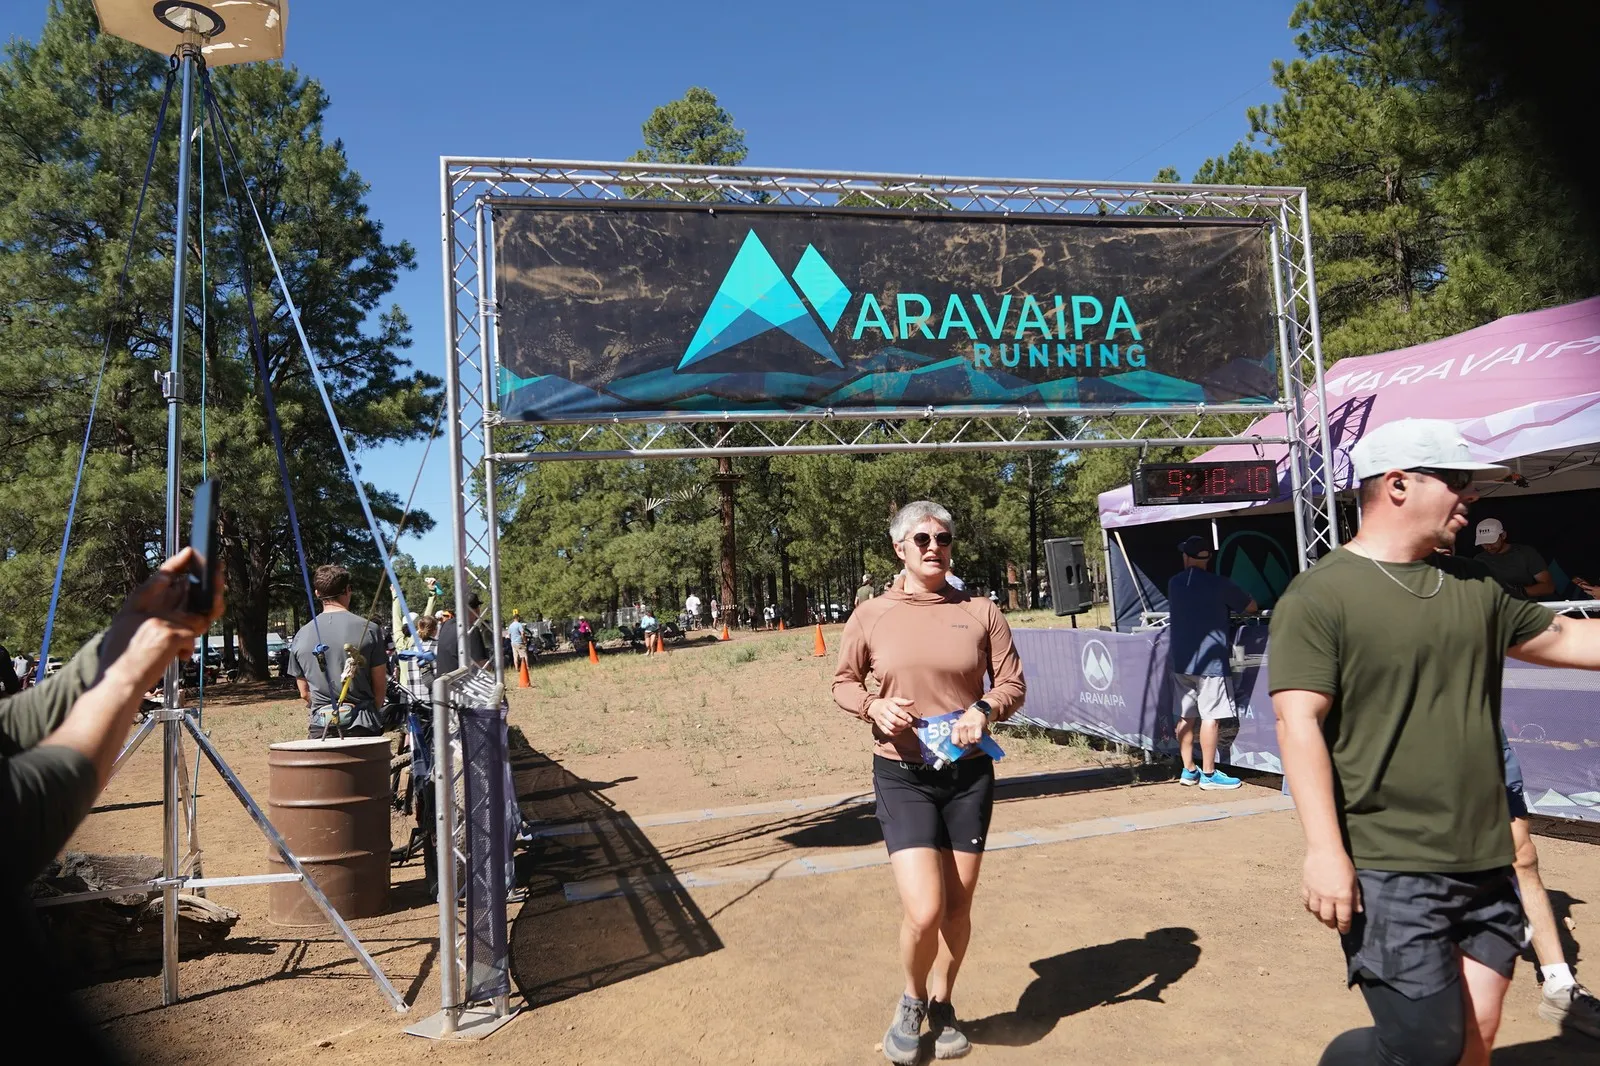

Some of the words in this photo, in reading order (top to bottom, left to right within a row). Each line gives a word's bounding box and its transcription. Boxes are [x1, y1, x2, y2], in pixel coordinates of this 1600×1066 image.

[851, 293, 1142, 341] ARAVAIPA
[973, 343, 1146, 368] RUNNING
[1079, 691, 1127, 708] ARAVAIPA
